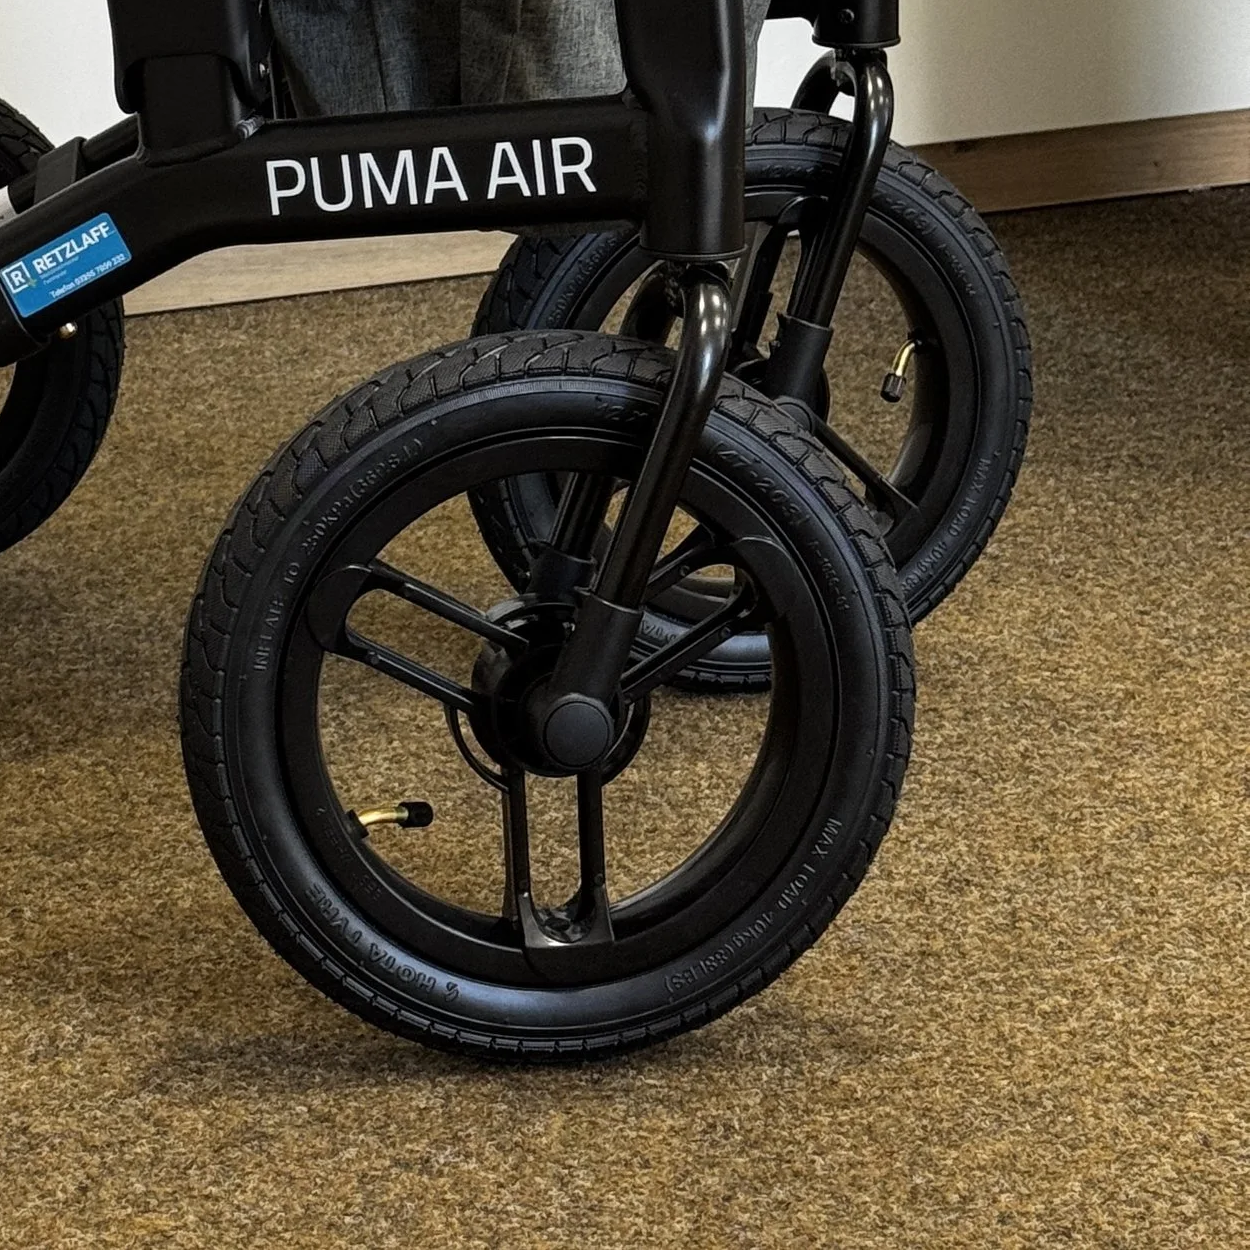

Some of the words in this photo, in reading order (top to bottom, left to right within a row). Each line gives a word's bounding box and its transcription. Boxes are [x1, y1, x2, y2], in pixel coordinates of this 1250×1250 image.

[266, 146, 469, 215] PUMA
[487, 136, 597, 199] AIR
[32, 222, 110, 274] RETZLAFF
[10, 270, 26, 286] R
[811, 817, 842, 860] MAX
[776, 862, 816, 910] LOAD
